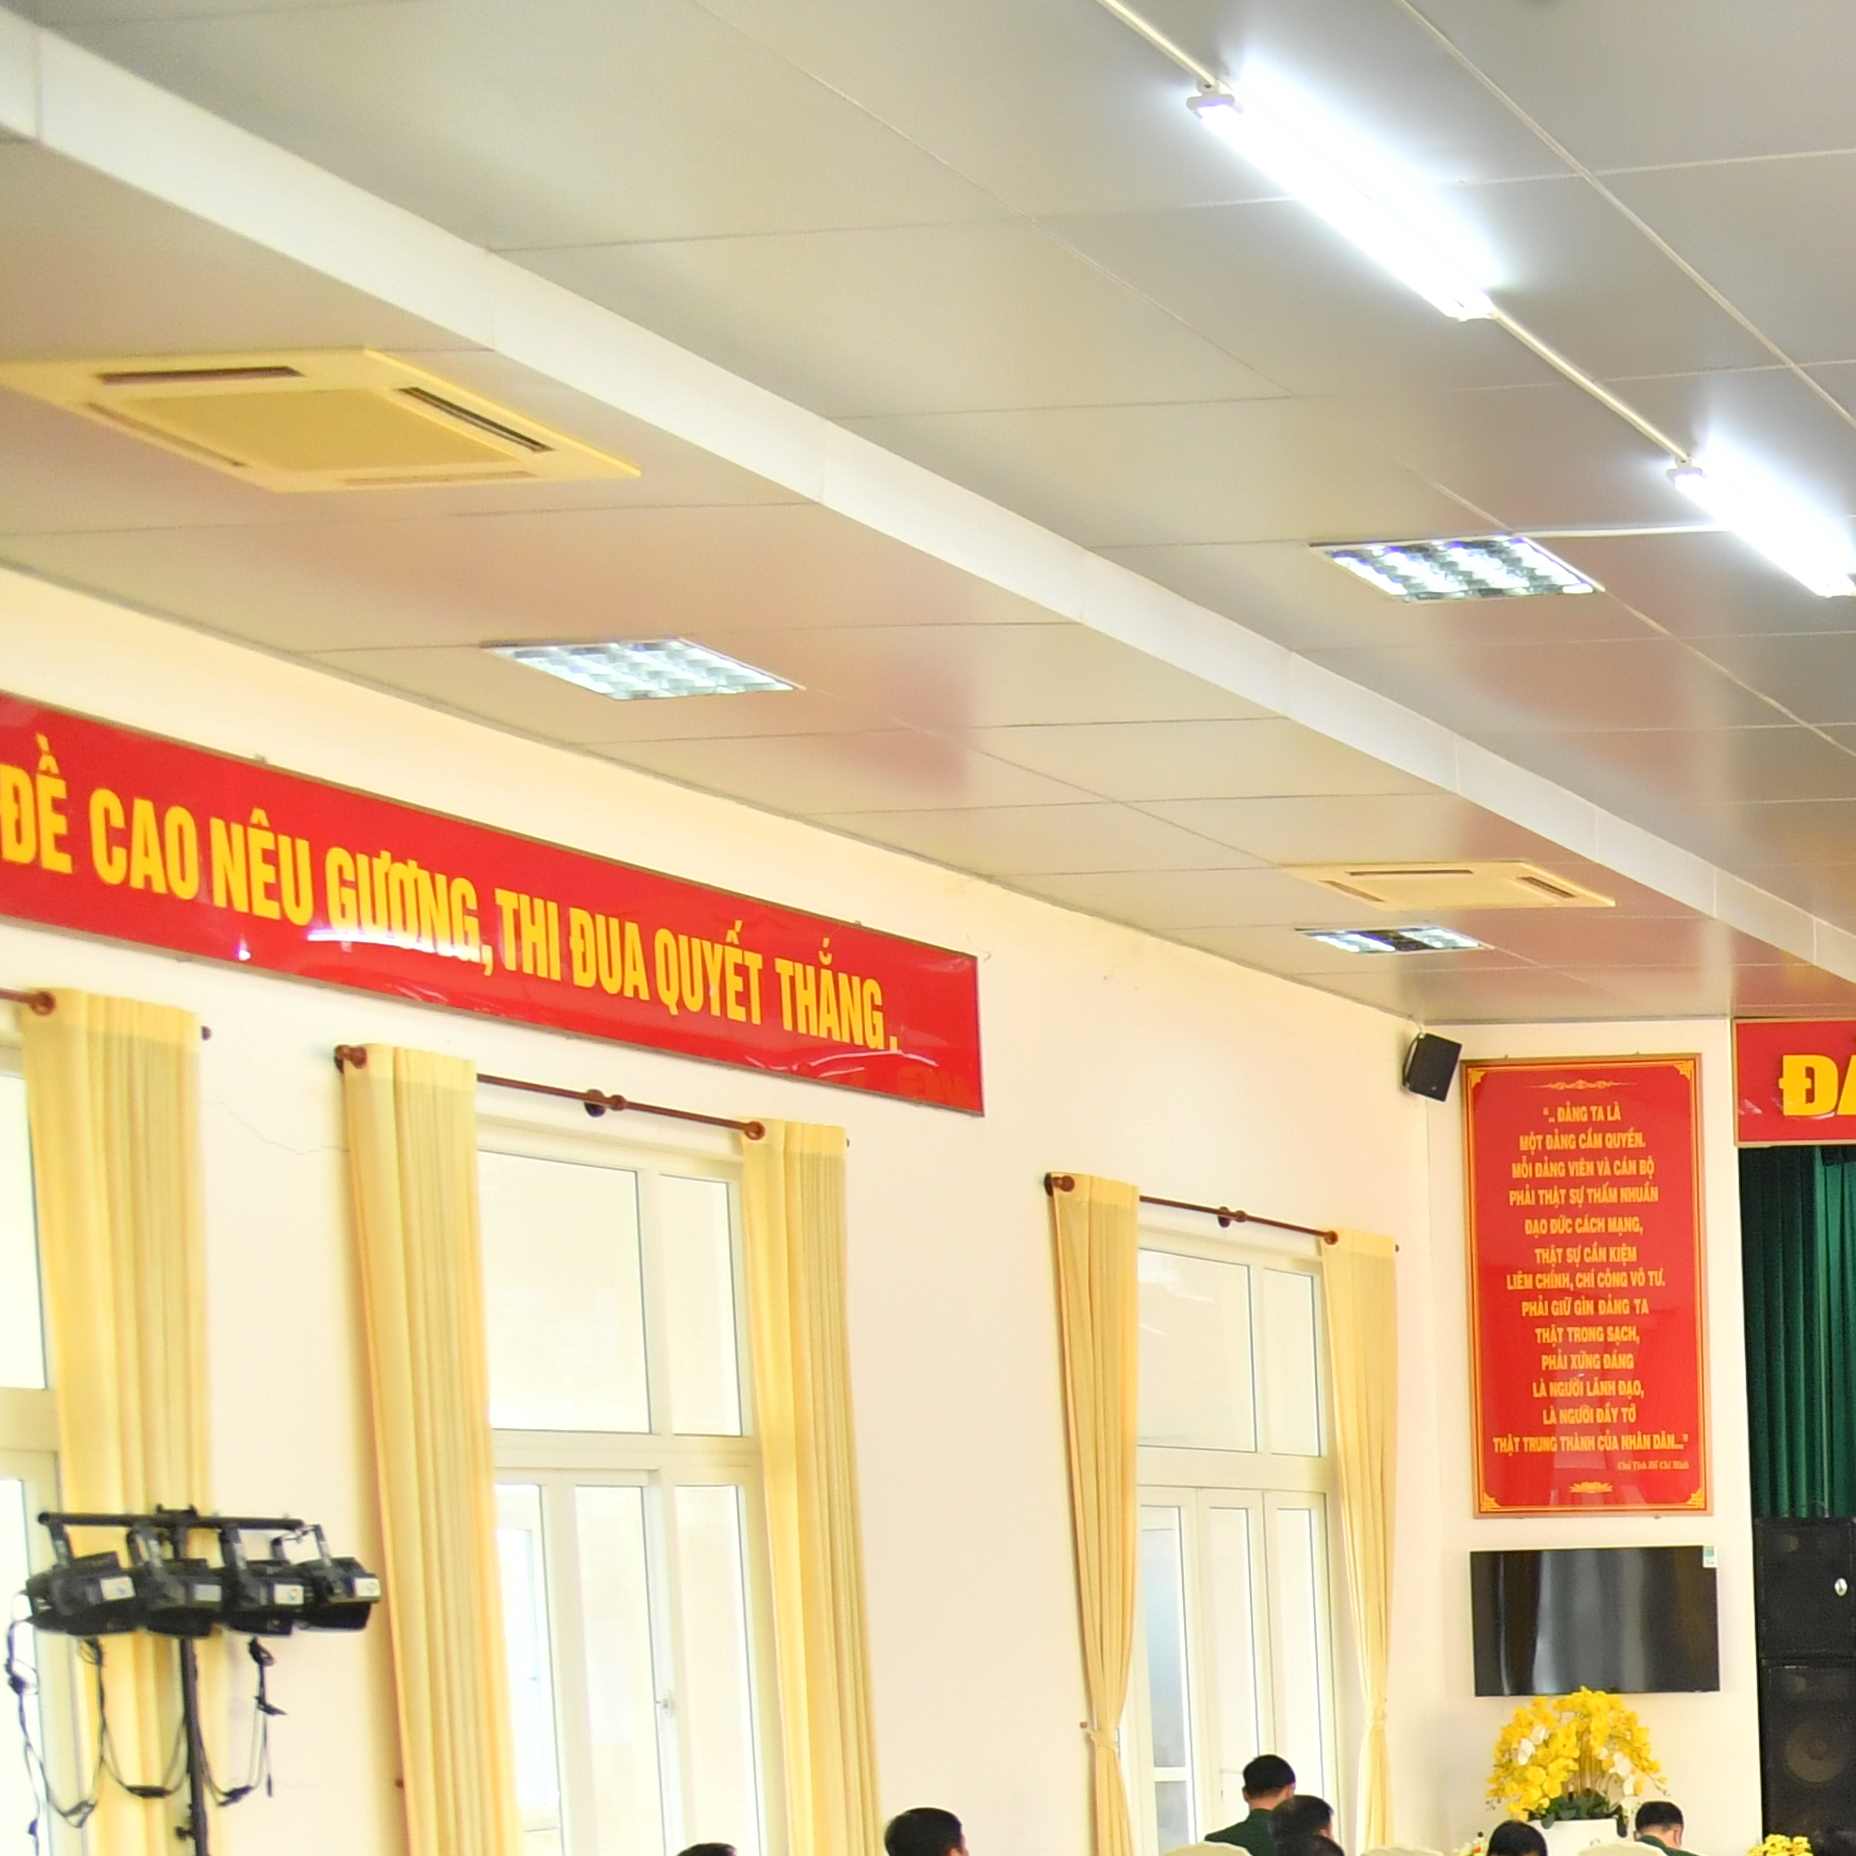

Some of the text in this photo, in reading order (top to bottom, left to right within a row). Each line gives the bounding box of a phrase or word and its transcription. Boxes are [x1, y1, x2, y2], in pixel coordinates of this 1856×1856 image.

[0, 732, 903, 1053] ĐỀ CAO NÊU GƯƠNG, THI ĐUA QUYẾT THẮNG.
[1590, 1105, 1603, 1121] TA
[1607, 1101, 1621, 1121] LÀ
[1546, 1129, 1576, 1150] ĐẢNG
[1535, 1156, 1565, 1177] ĐẢNG
[1597, 1156, 1612, 1176] VÀ
[1640, 1155, 1654, 1180] BỘ
[1509, 1184, 1535, 1206] PHẢI
[1538, 1186, 1566, 1208] THẬT
[1525, 1219, 1547, 1239] ĐẠO
[1575, 1214, 1605, 1234] CÁCH
[1535, 1245, 1563, 1268] THẬT
[1576, 1268, 1594, 1288] CHÍ
[1522, 1295, 1548, 1317] PHẢI
[1598, 1294, 1629, 1315] ĐẢNG
[1634, 1299, 1648, 1314] TA
[1535, 1324, 1564, 1347] THẬT
[1567, 1327, 1603, 1343] TRONG
[1542, 1349, 1567, 1370] PHẢI
[1532, 1378, 1547, 1398] LÀ
[1543, 1405, 1556, 1424] LÀ
[1493, 1434, 1520, 1457] THẬT
[1597, 1430, 1618, 1451] CỦA
